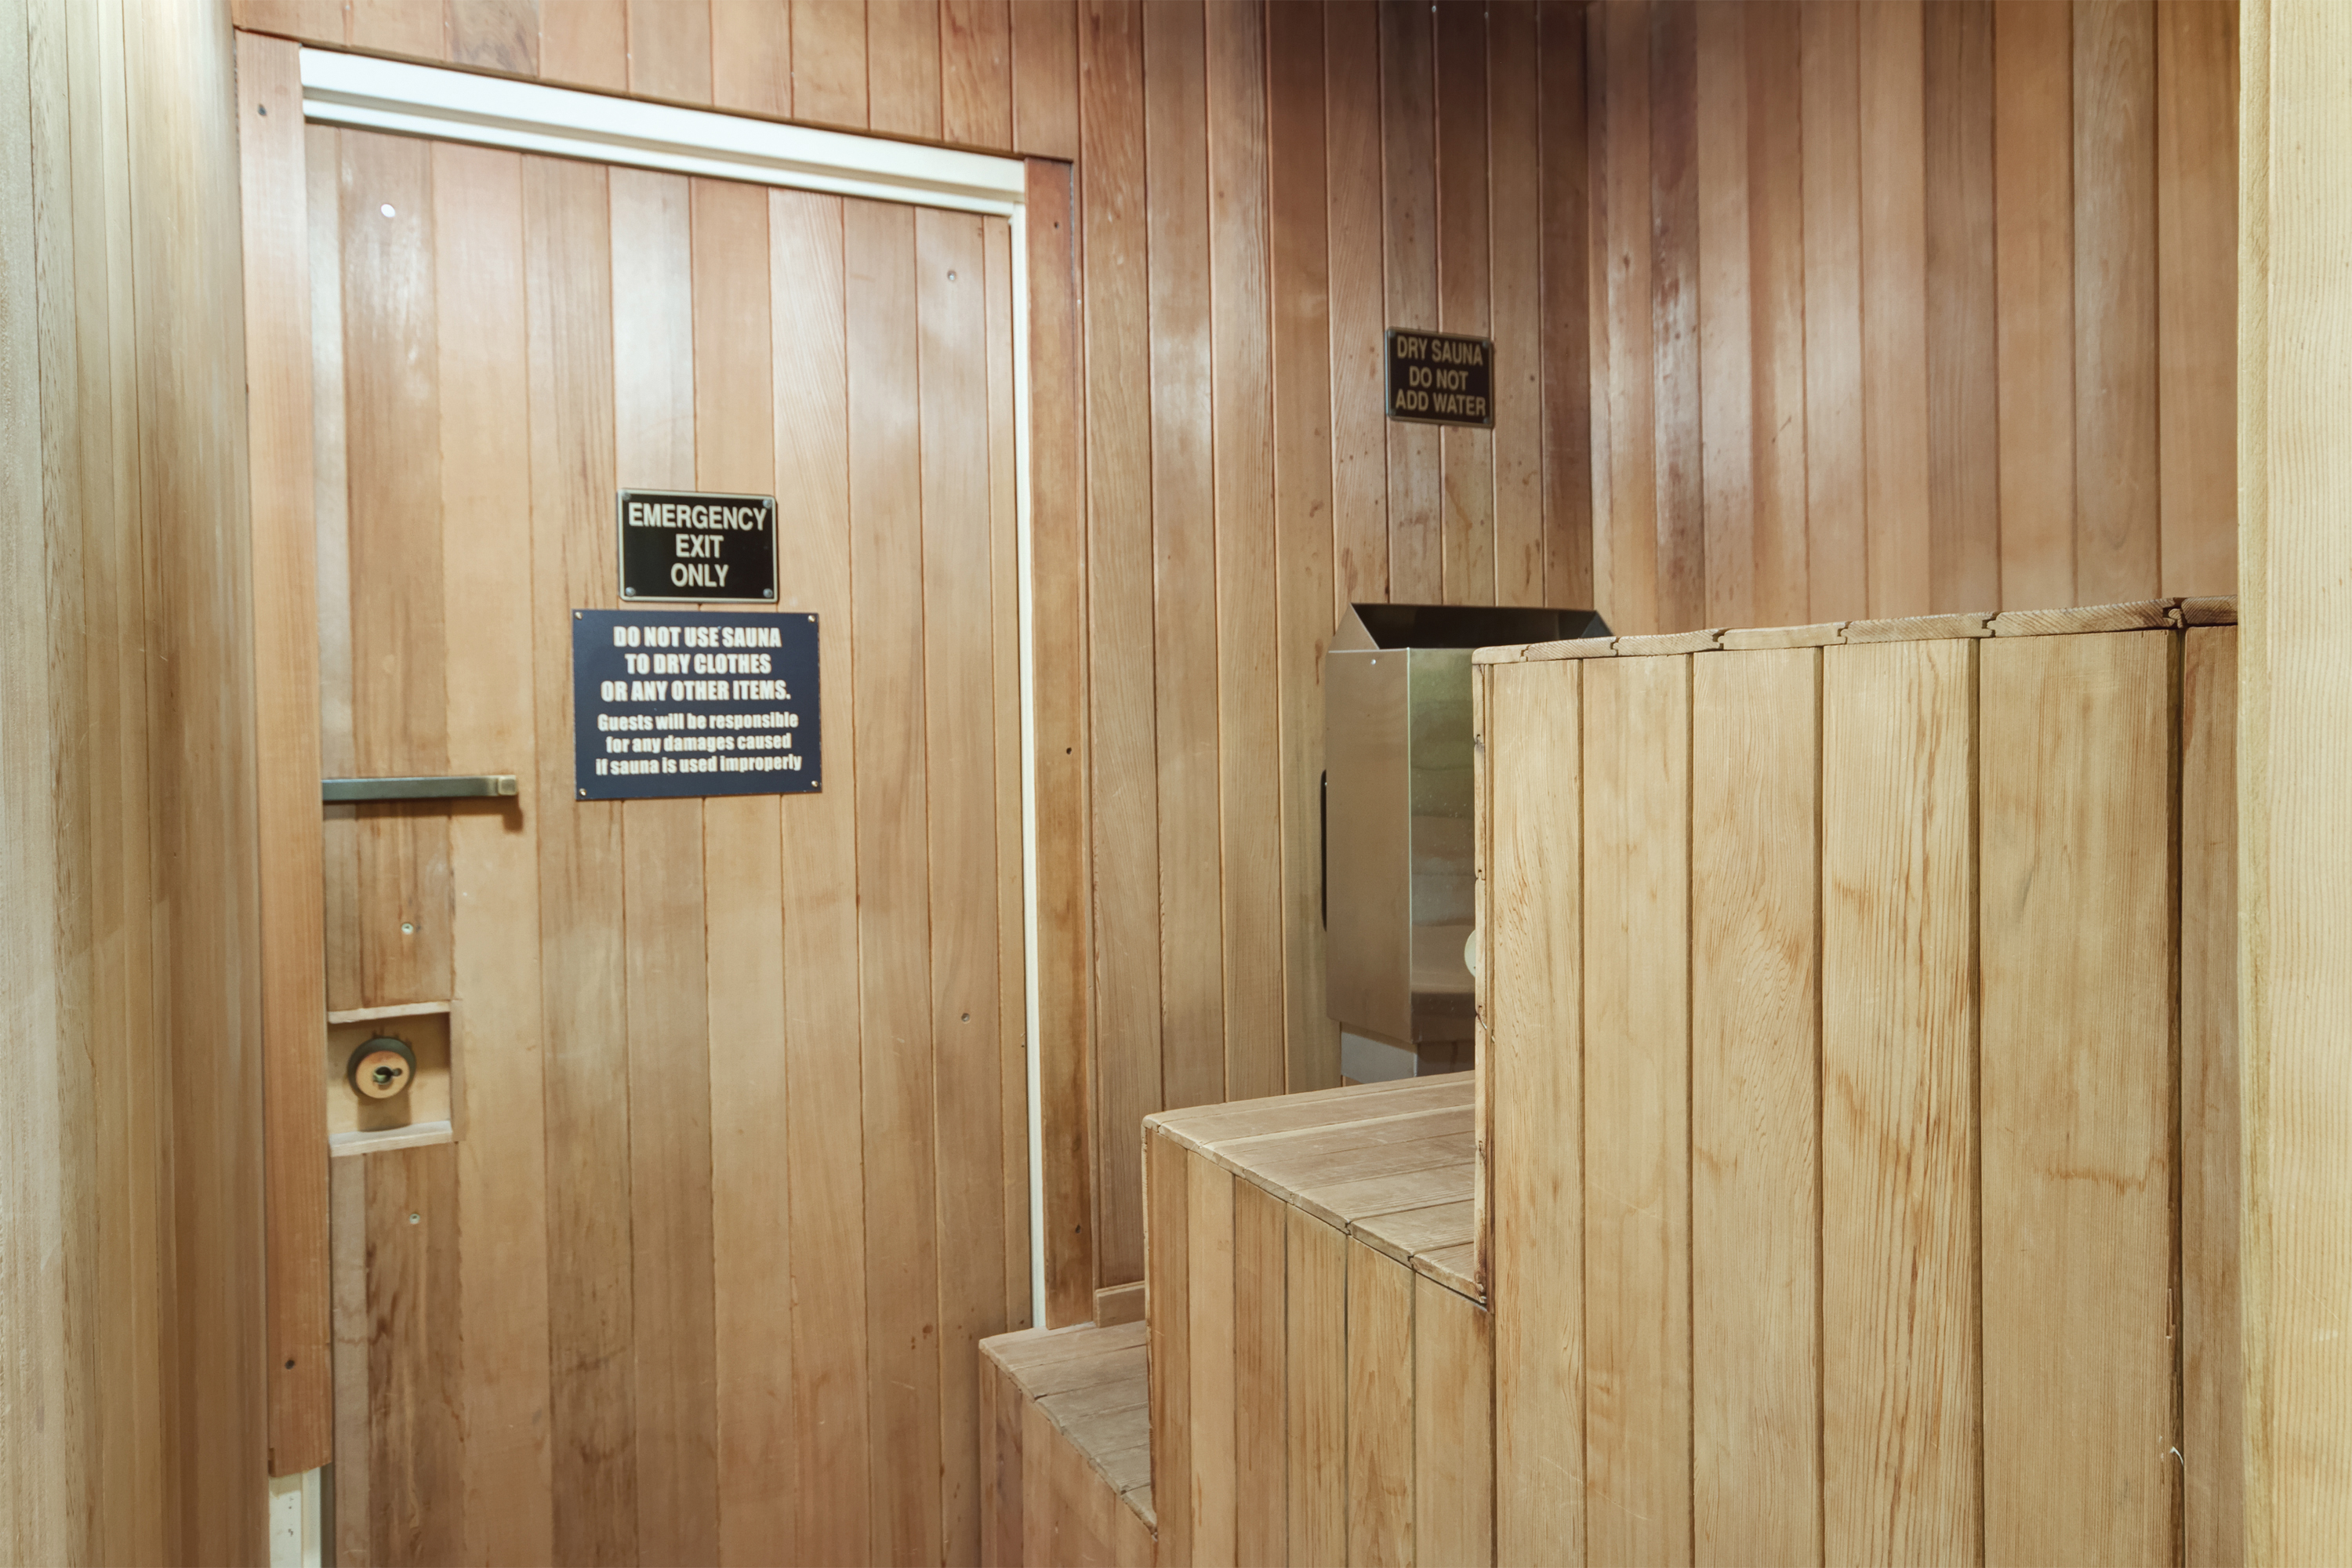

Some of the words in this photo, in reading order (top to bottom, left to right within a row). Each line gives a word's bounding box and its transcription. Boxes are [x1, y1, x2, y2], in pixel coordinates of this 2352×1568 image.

[1397, 336, 1428, 361] DRY
[1432, 339, 1483, 366] SAUNA
[1409, 365, 1432, 388] DO
[1436, 368, 1468, 391] NOT
[1396, 388, 1429, 412] ADD
[1432, 392, 1486, 416] WATER
[629, 502, 767, 531] EMERGENCY
[676, 533, 724, 558] EXIT
[670, 563, 729, 587] ONLY
[613, 626, 641, 648] DO
[644, 626, 681, 648] NOT
[684, 626, 720, 648] USE
[721, 626, 782, 648] SAUNA
[625, 653, 650, 674] TO
[653, 653, 691, 674] DRY
[694, 653, 771, 674] CLOTHES
[601, 681, 628, 702] OR
[630, 681, 669, 702] ANY
[671, 680, 730, 702] OTHER
[732, 680, 791, 701] ITEMS.
[597, 713, 653, 731] Guests
[655, 713, 684, 731] will
[687, 713, 706, 730] be
[709, 711, 799, 730] responsible
[606, 735, 630, 753] for
[632, 737, 661, 753] any
[663, 735, 735, 753] damages
[737, 732, 792, 750] caused
[610, 759, 660, 775] sauna
[662, 757, 677, 773] is
[679, 755, 717, 773] used
[720, 753, 802, 772] improperly
